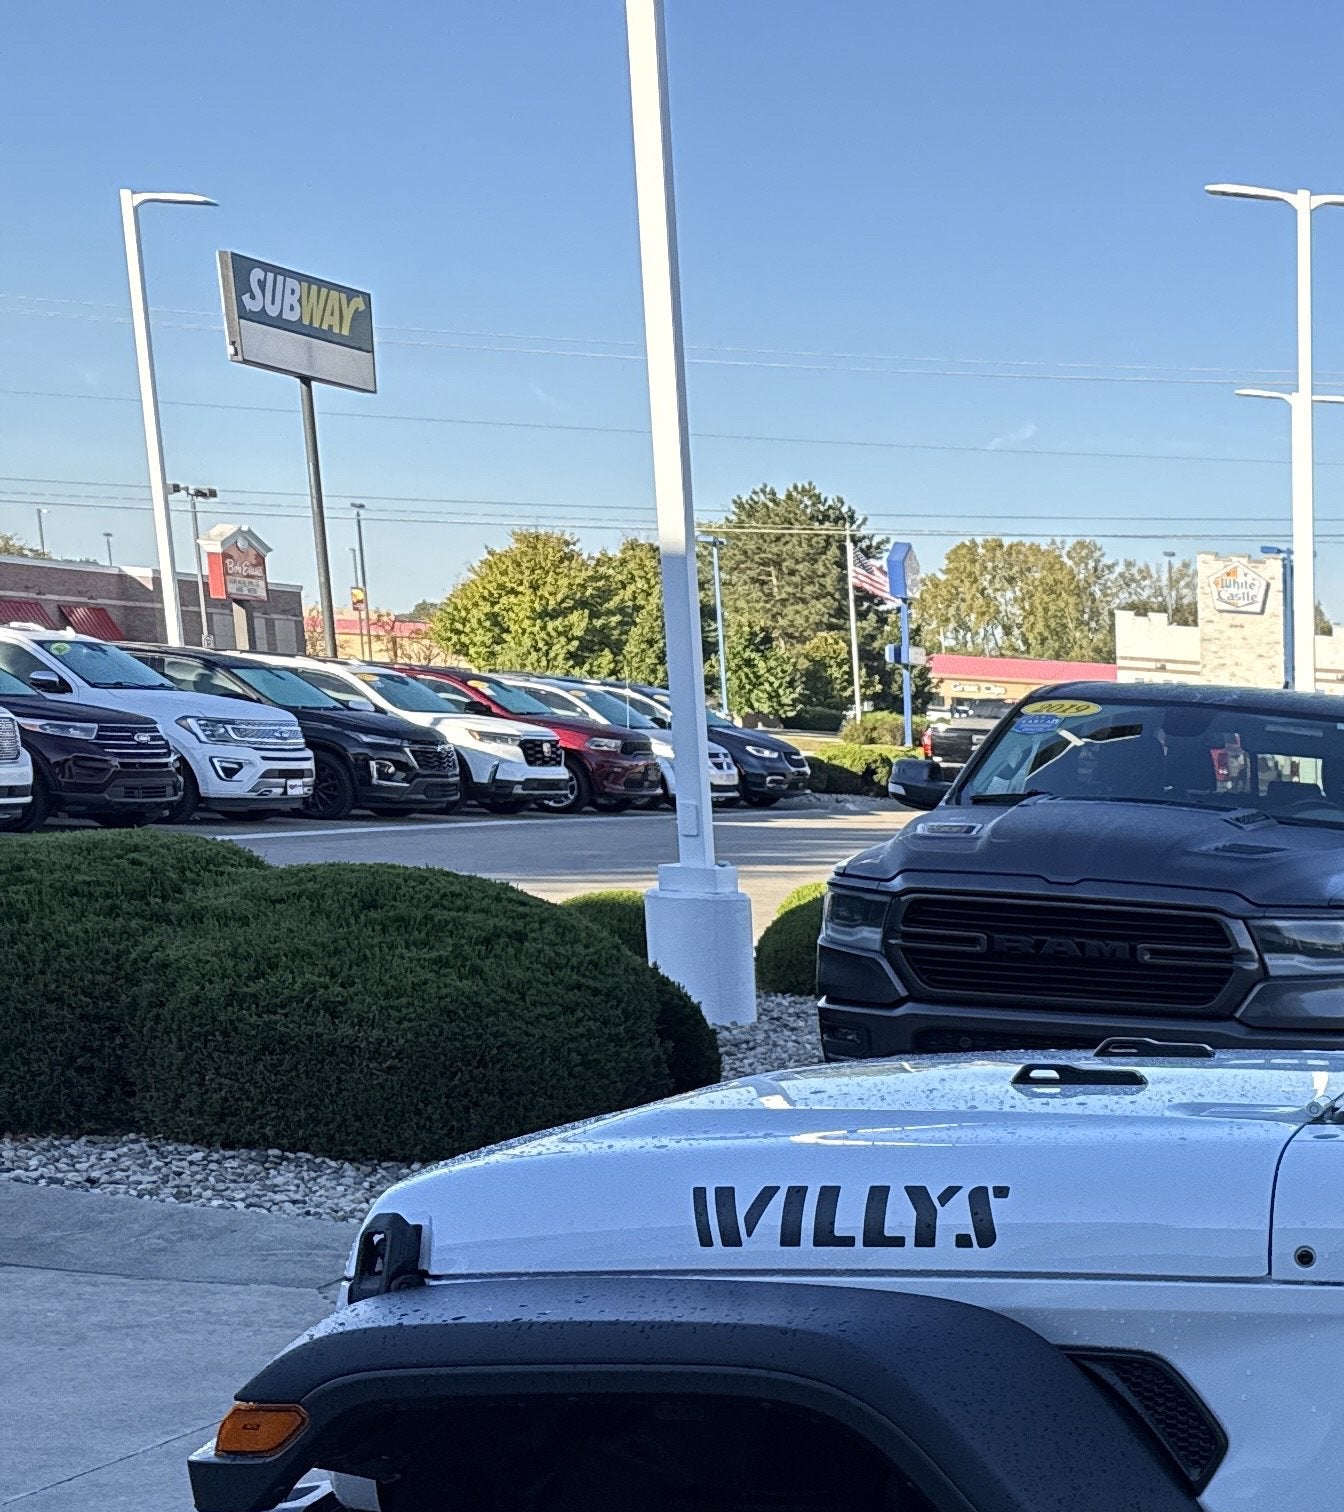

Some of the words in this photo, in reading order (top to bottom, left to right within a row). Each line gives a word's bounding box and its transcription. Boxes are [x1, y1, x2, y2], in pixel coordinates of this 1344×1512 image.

[242, 267, 366, 336] SUBWAY
[1219, 578, 1257, 590] White
[1217, 590, 1258, 602] Castle
[1031, 703, 1091, 714] 2019
[993, 934, 1130, 961] RAM
[692, 1185, 1011, 1249] WILLYS
